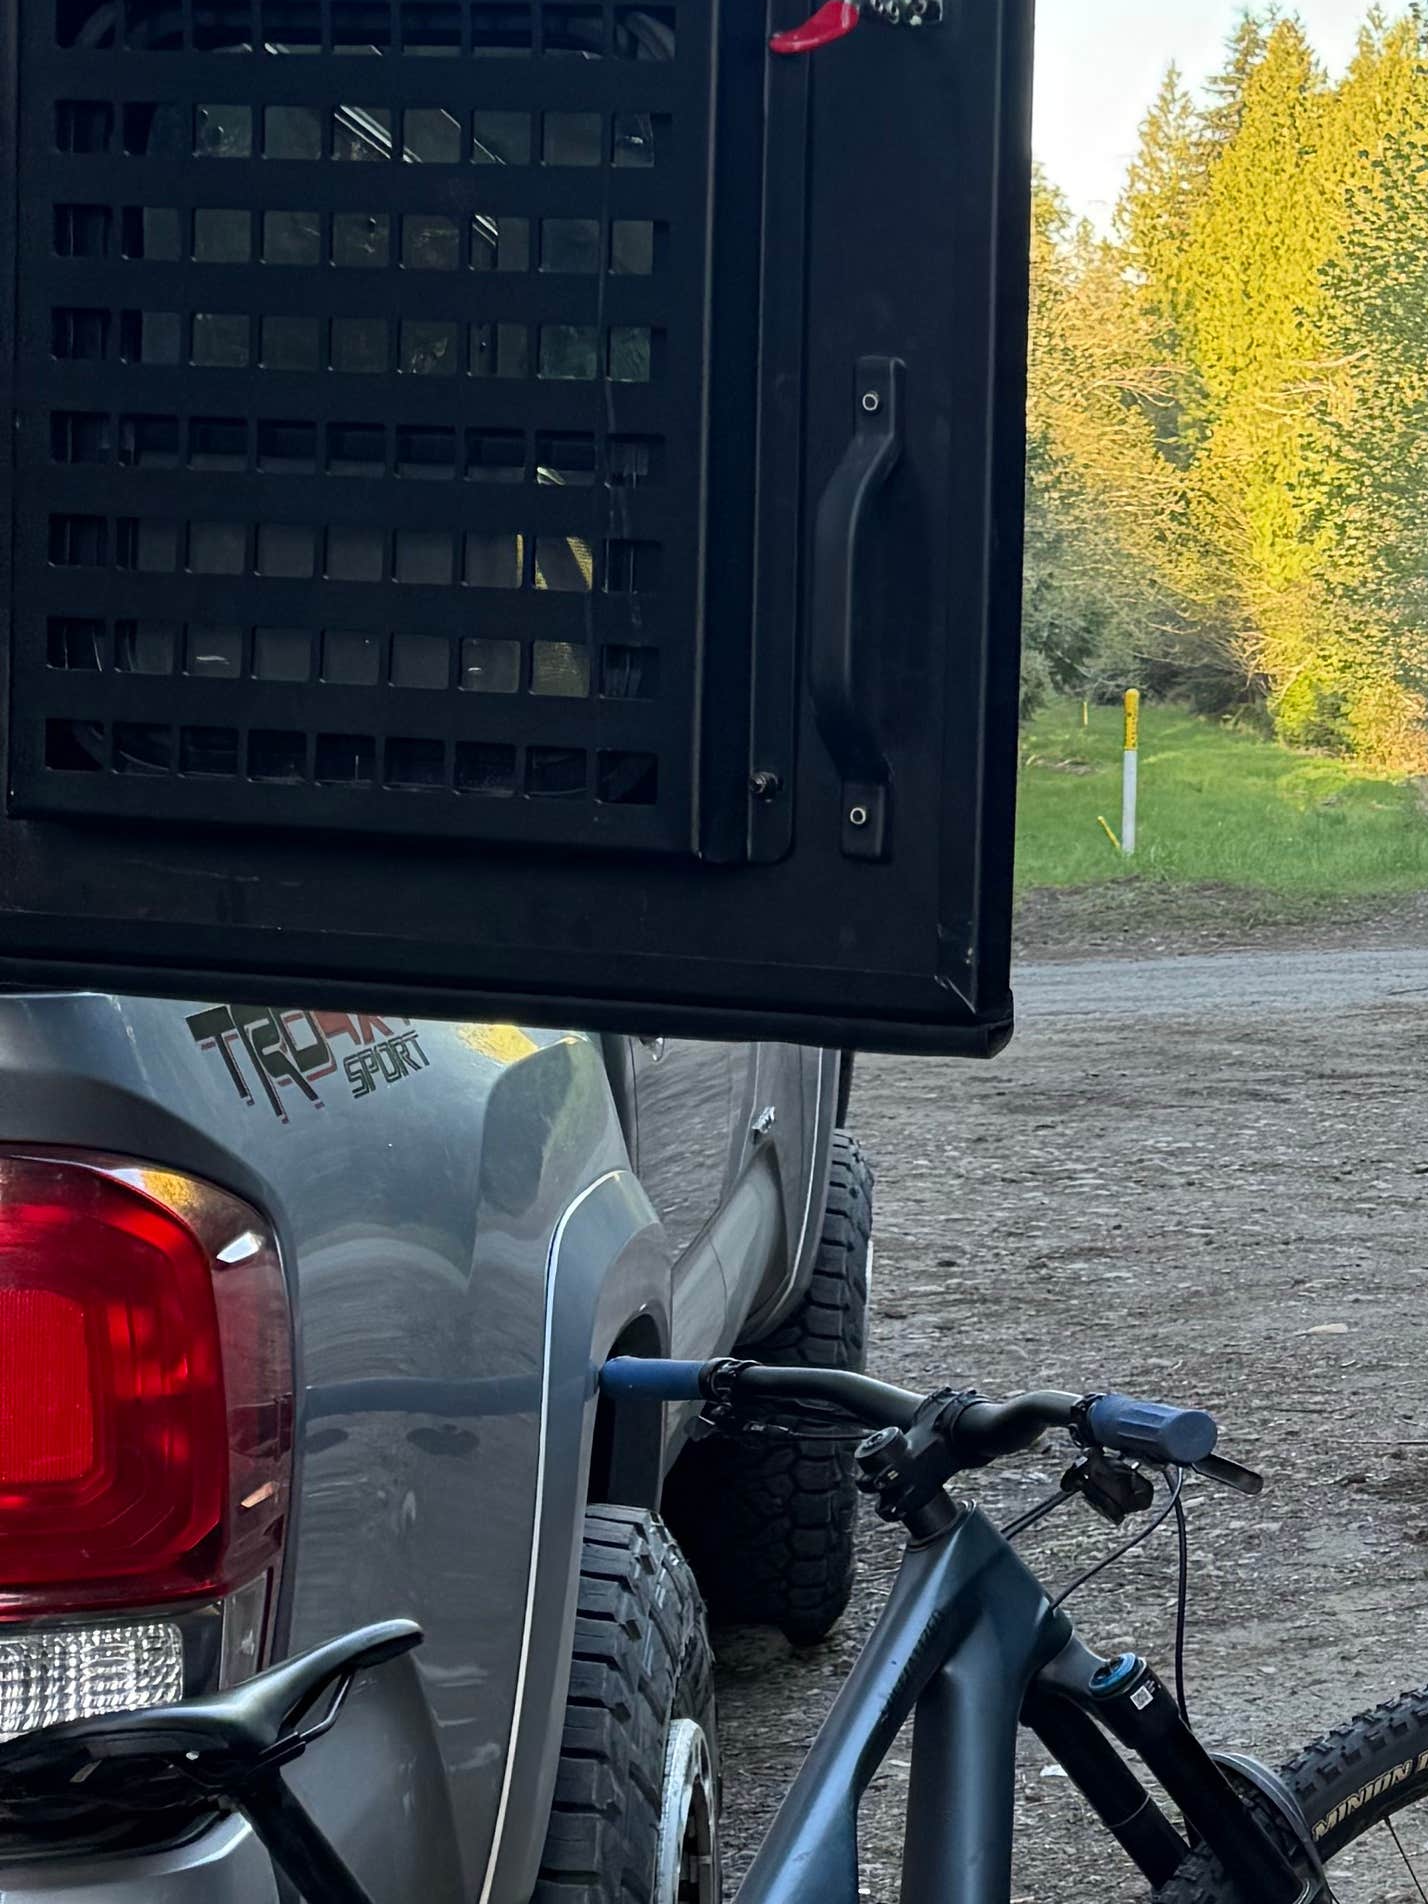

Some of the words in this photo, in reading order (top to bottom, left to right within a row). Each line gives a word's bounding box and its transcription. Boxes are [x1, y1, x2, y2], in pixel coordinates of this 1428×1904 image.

[184, 1004, 338, 1124] TRD
[343, 1029, 431, 1099] SPORT
[1312, 1758, 1412, 1842] MINION
